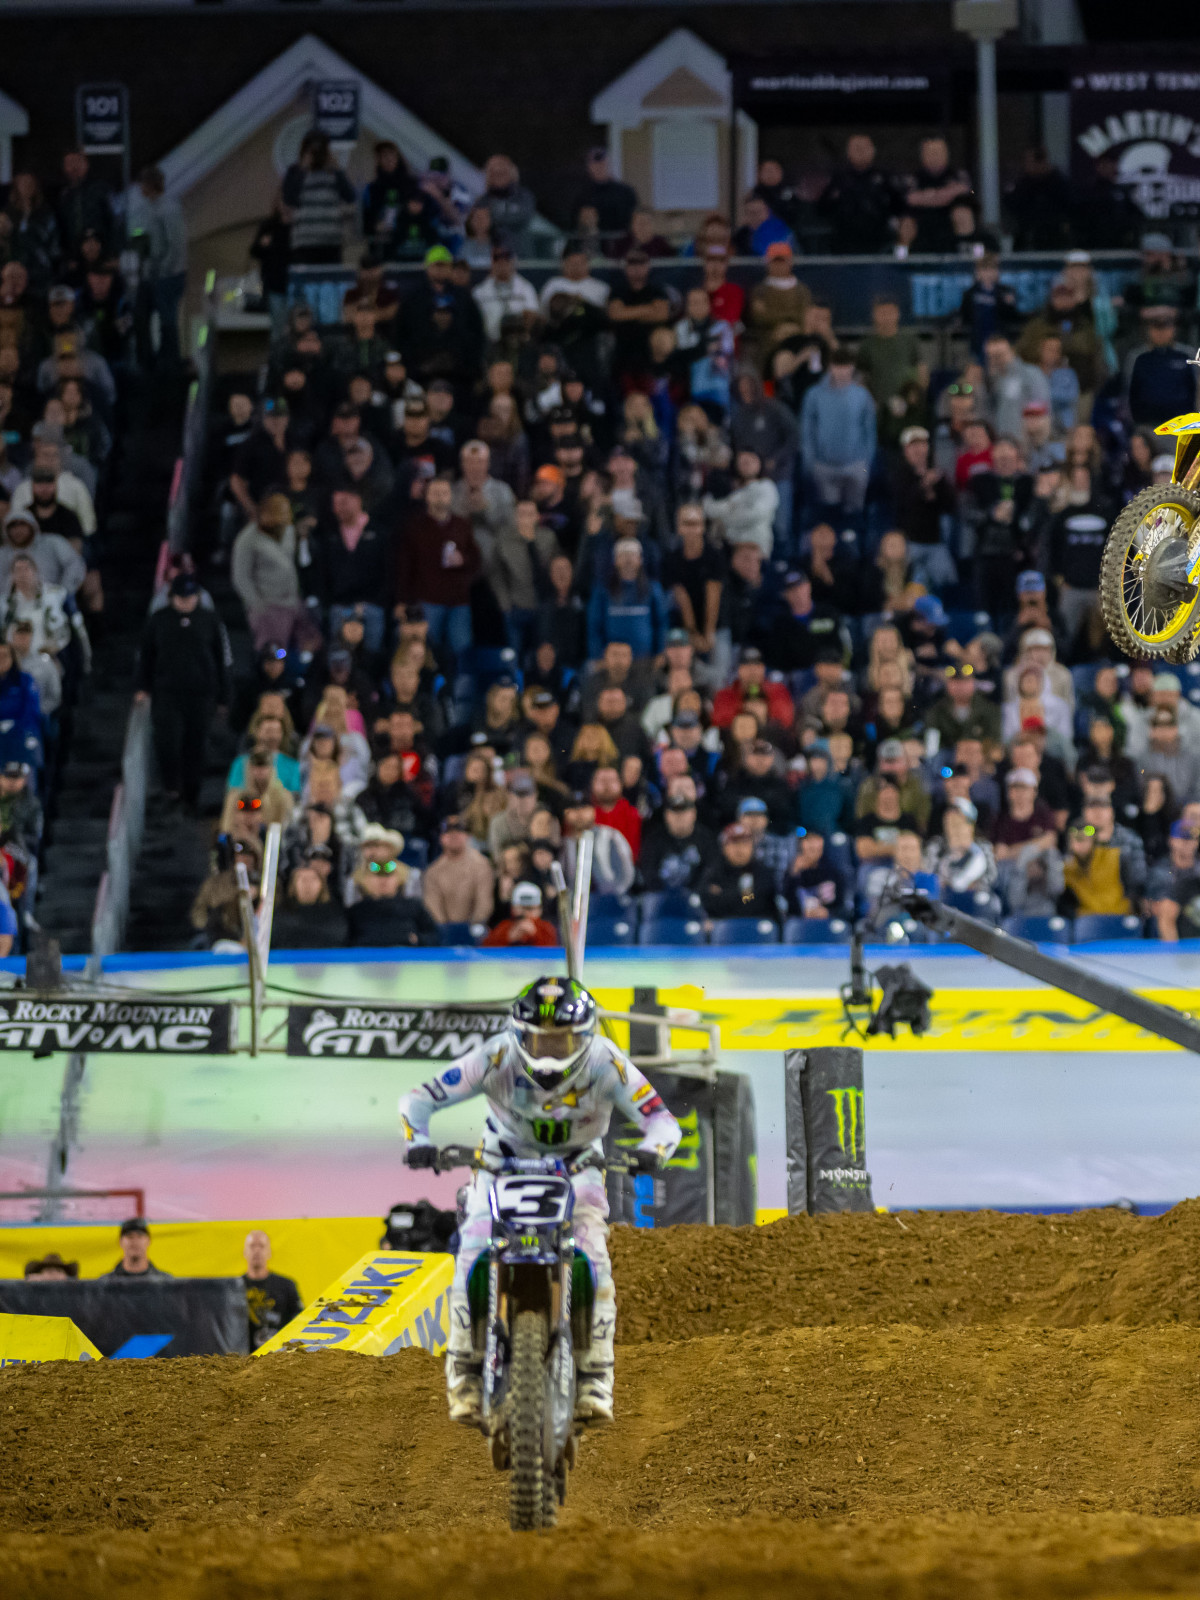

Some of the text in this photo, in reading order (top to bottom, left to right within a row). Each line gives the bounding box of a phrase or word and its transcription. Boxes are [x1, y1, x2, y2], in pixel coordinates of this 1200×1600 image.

[1088, 72, 1149, 90] WEST
[13, 1000, 214, 1025] ROCKY MOUNTAIN
[341, 1007, 417, 1029] ROCKY
[820, 1167, 866, 1181] MONST
[504, 1179, 569, 1220] 3
[278, 1257, 425, 1352] UZUKI
